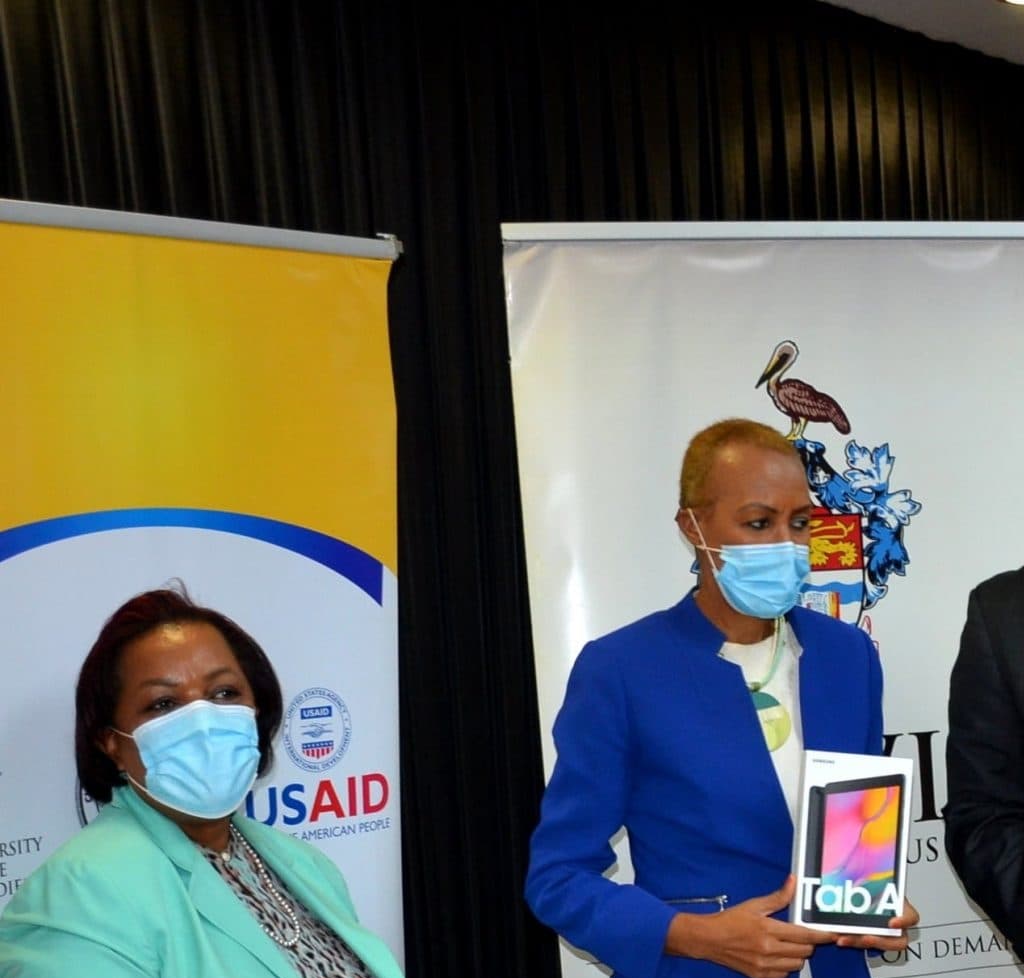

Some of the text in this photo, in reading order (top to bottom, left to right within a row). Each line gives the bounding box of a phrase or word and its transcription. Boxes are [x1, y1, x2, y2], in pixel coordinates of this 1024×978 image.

[302, 708, 330, 718] USAID
[245, 773, 390, 826] USAID
[301, 825, 356, 841] AMERICAN
[359, 817, 391, 832] PEOPLE
[802, 877, 901, 915] Tab A
